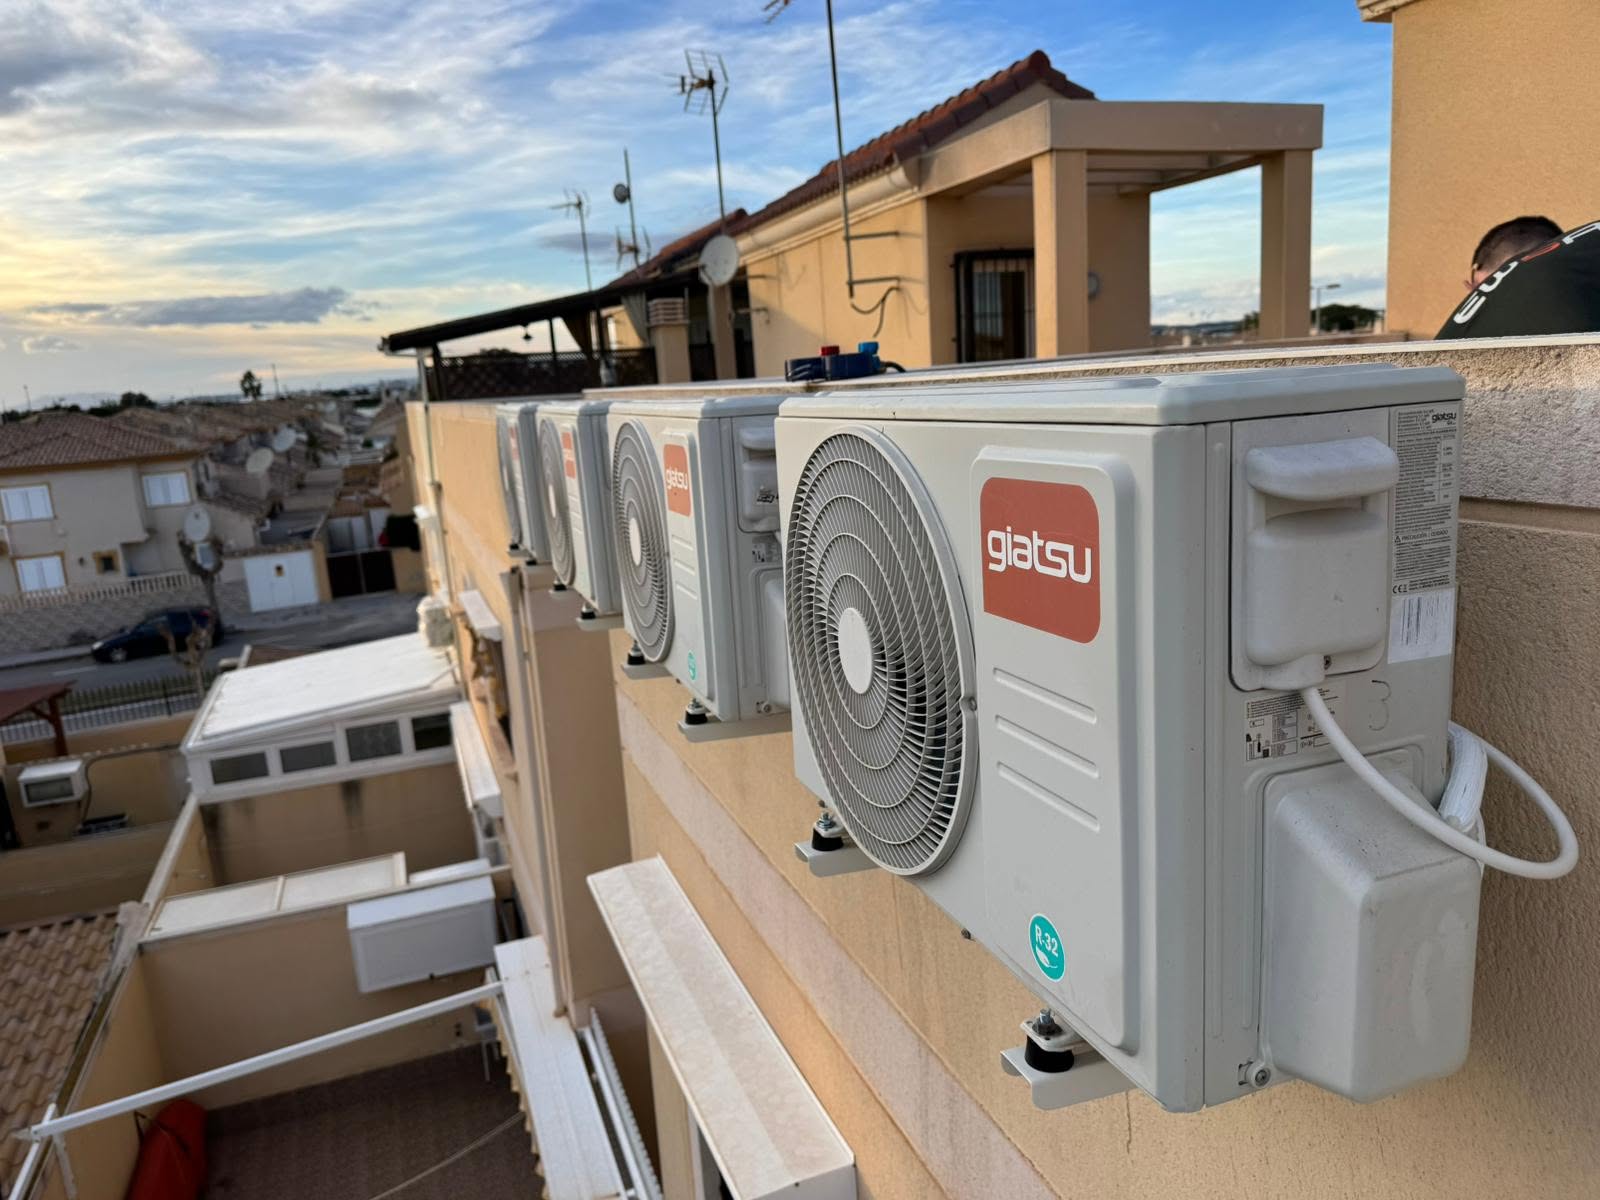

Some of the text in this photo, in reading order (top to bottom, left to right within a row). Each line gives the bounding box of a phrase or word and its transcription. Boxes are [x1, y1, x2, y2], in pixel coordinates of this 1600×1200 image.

[1431, 412, 1457, 424] giatsu
[987, 525, 1092, 584] giatsu
[1034, 923, 1059, 958] R-32
